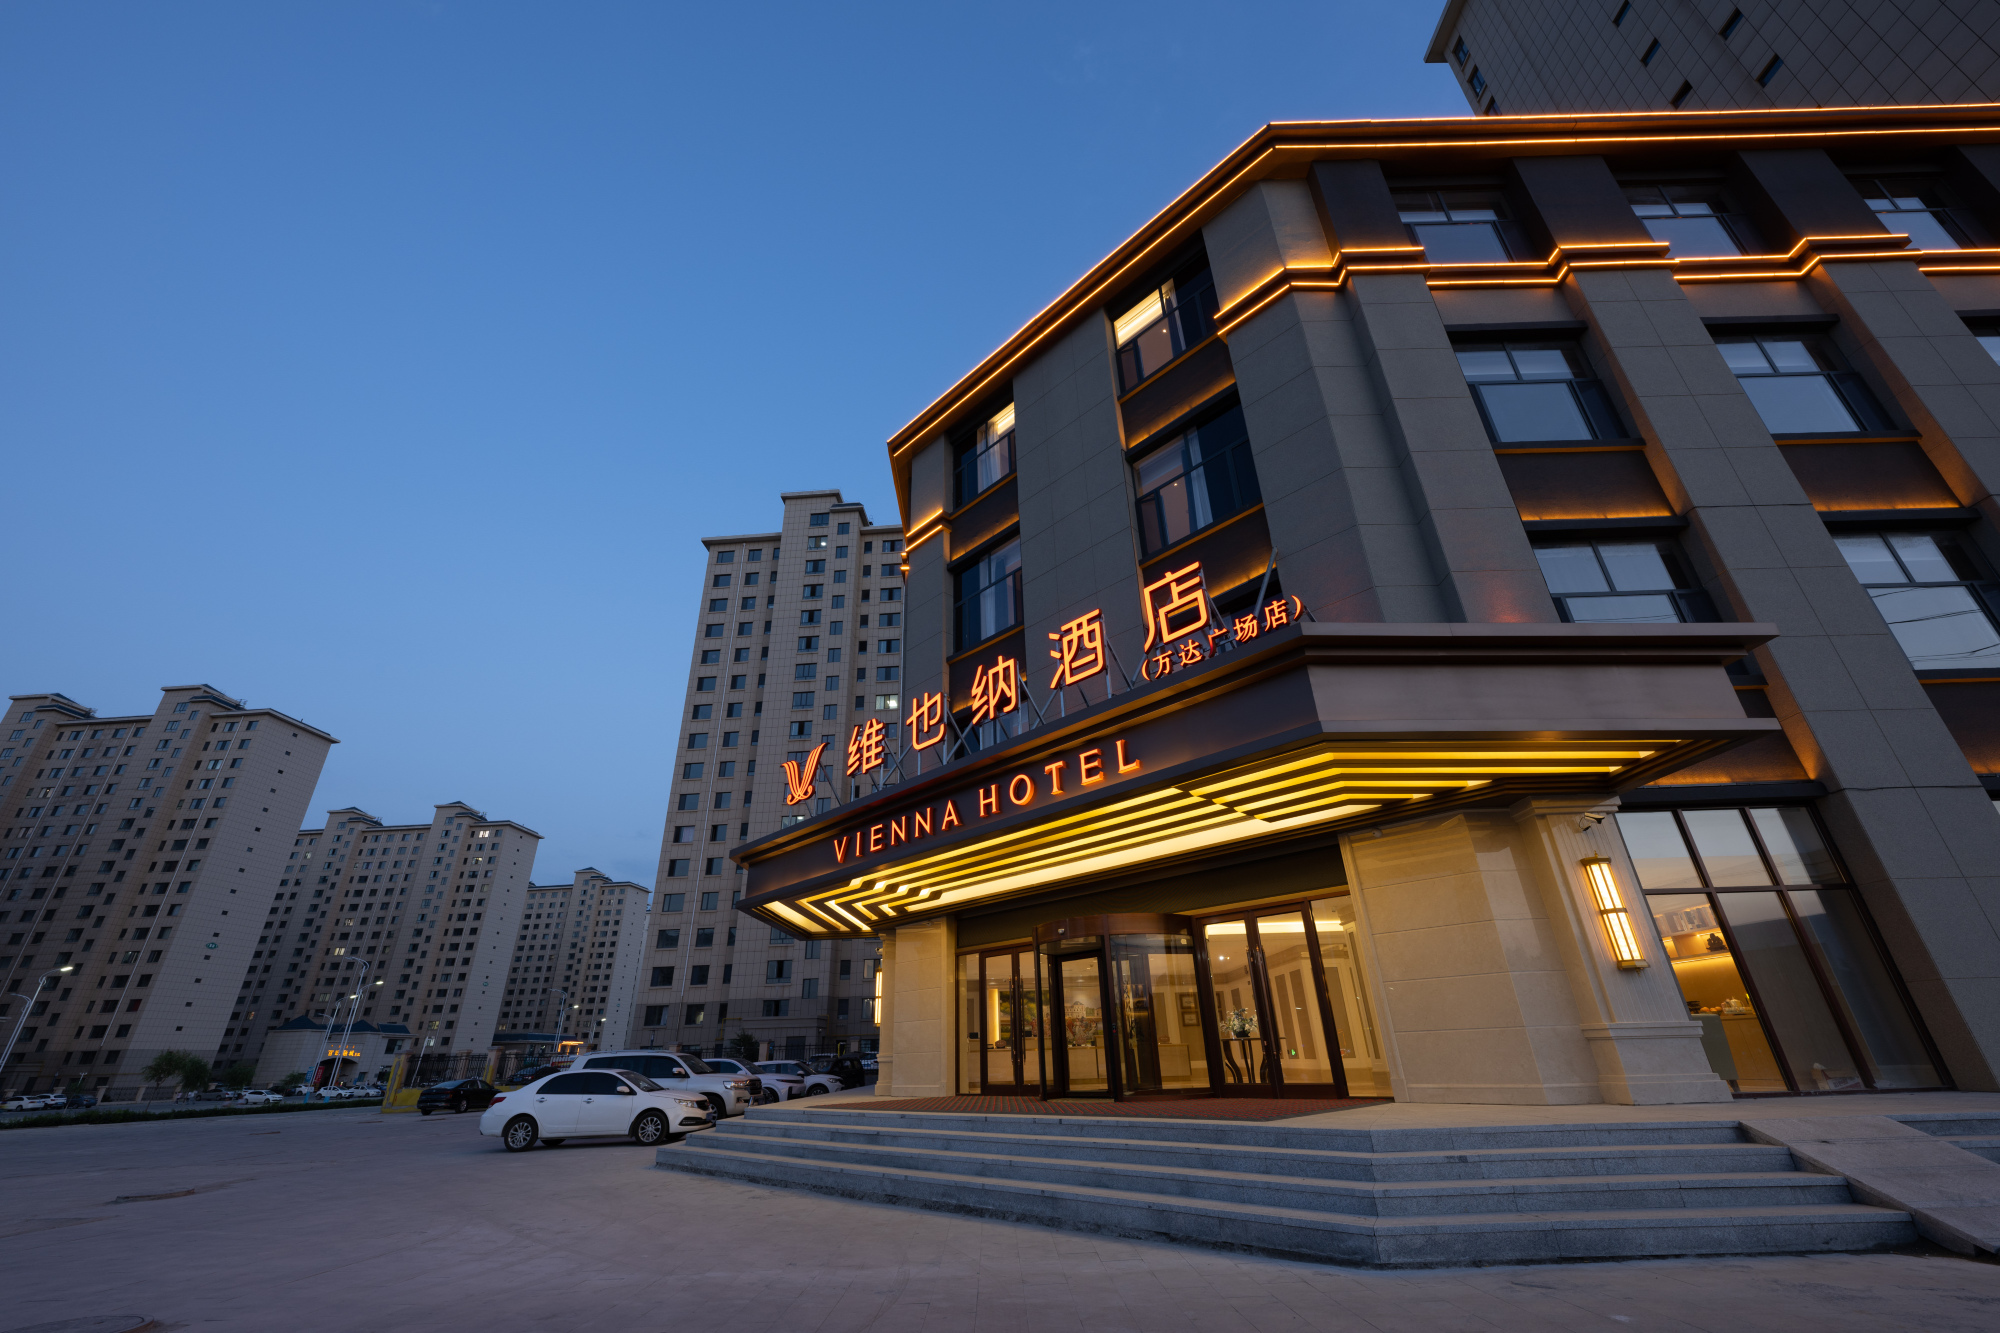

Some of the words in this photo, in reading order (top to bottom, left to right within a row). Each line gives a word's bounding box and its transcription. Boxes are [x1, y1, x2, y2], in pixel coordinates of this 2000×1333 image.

[846, 560, 1209, 776] 维也纳酒店
[1141, 594, 1304, 682] (万达广场店)
[833, 799, 963, 864] VIENNA
[978, 739, 1142, 818] HOTEL
